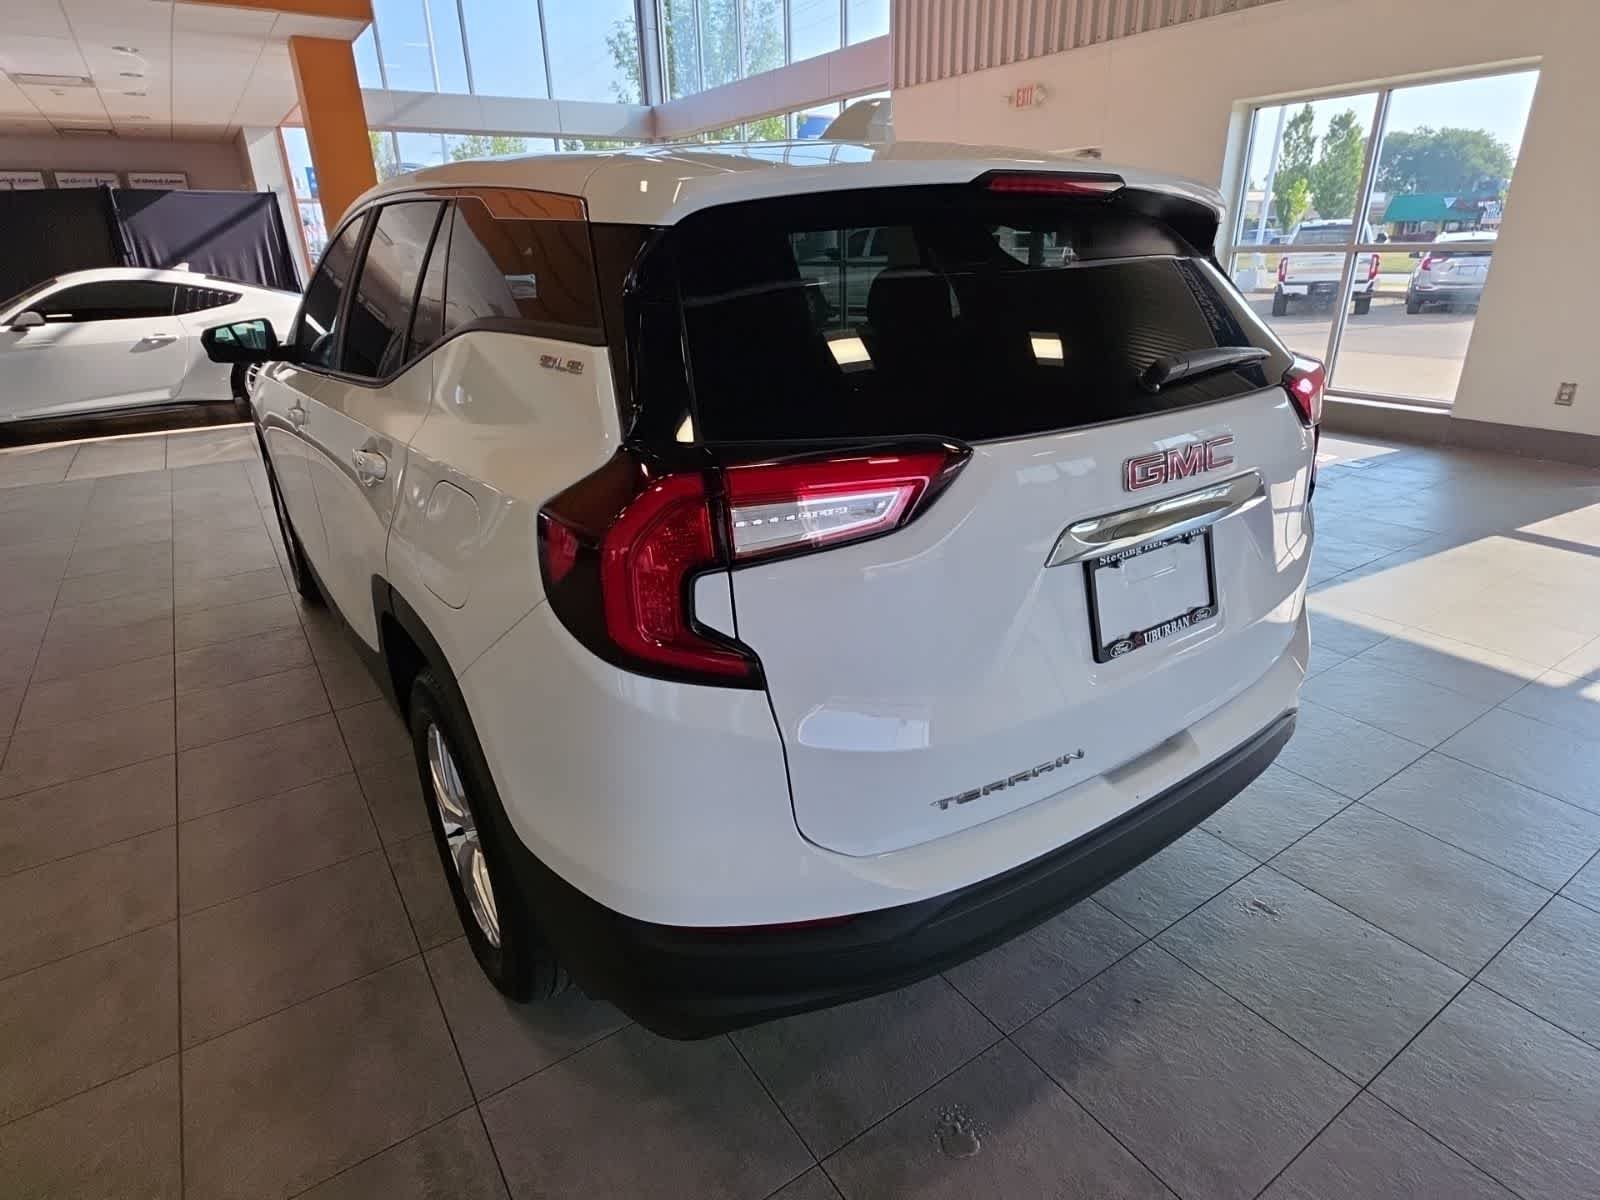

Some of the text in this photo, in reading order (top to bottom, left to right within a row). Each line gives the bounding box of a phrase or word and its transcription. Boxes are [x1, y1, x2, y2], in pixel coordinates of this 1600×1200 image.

[1015, 87, 1034, 108] EXIT
[1124, 434, 1234, 492] GMC
[930, 749, 1084, 810] TERRAIN
